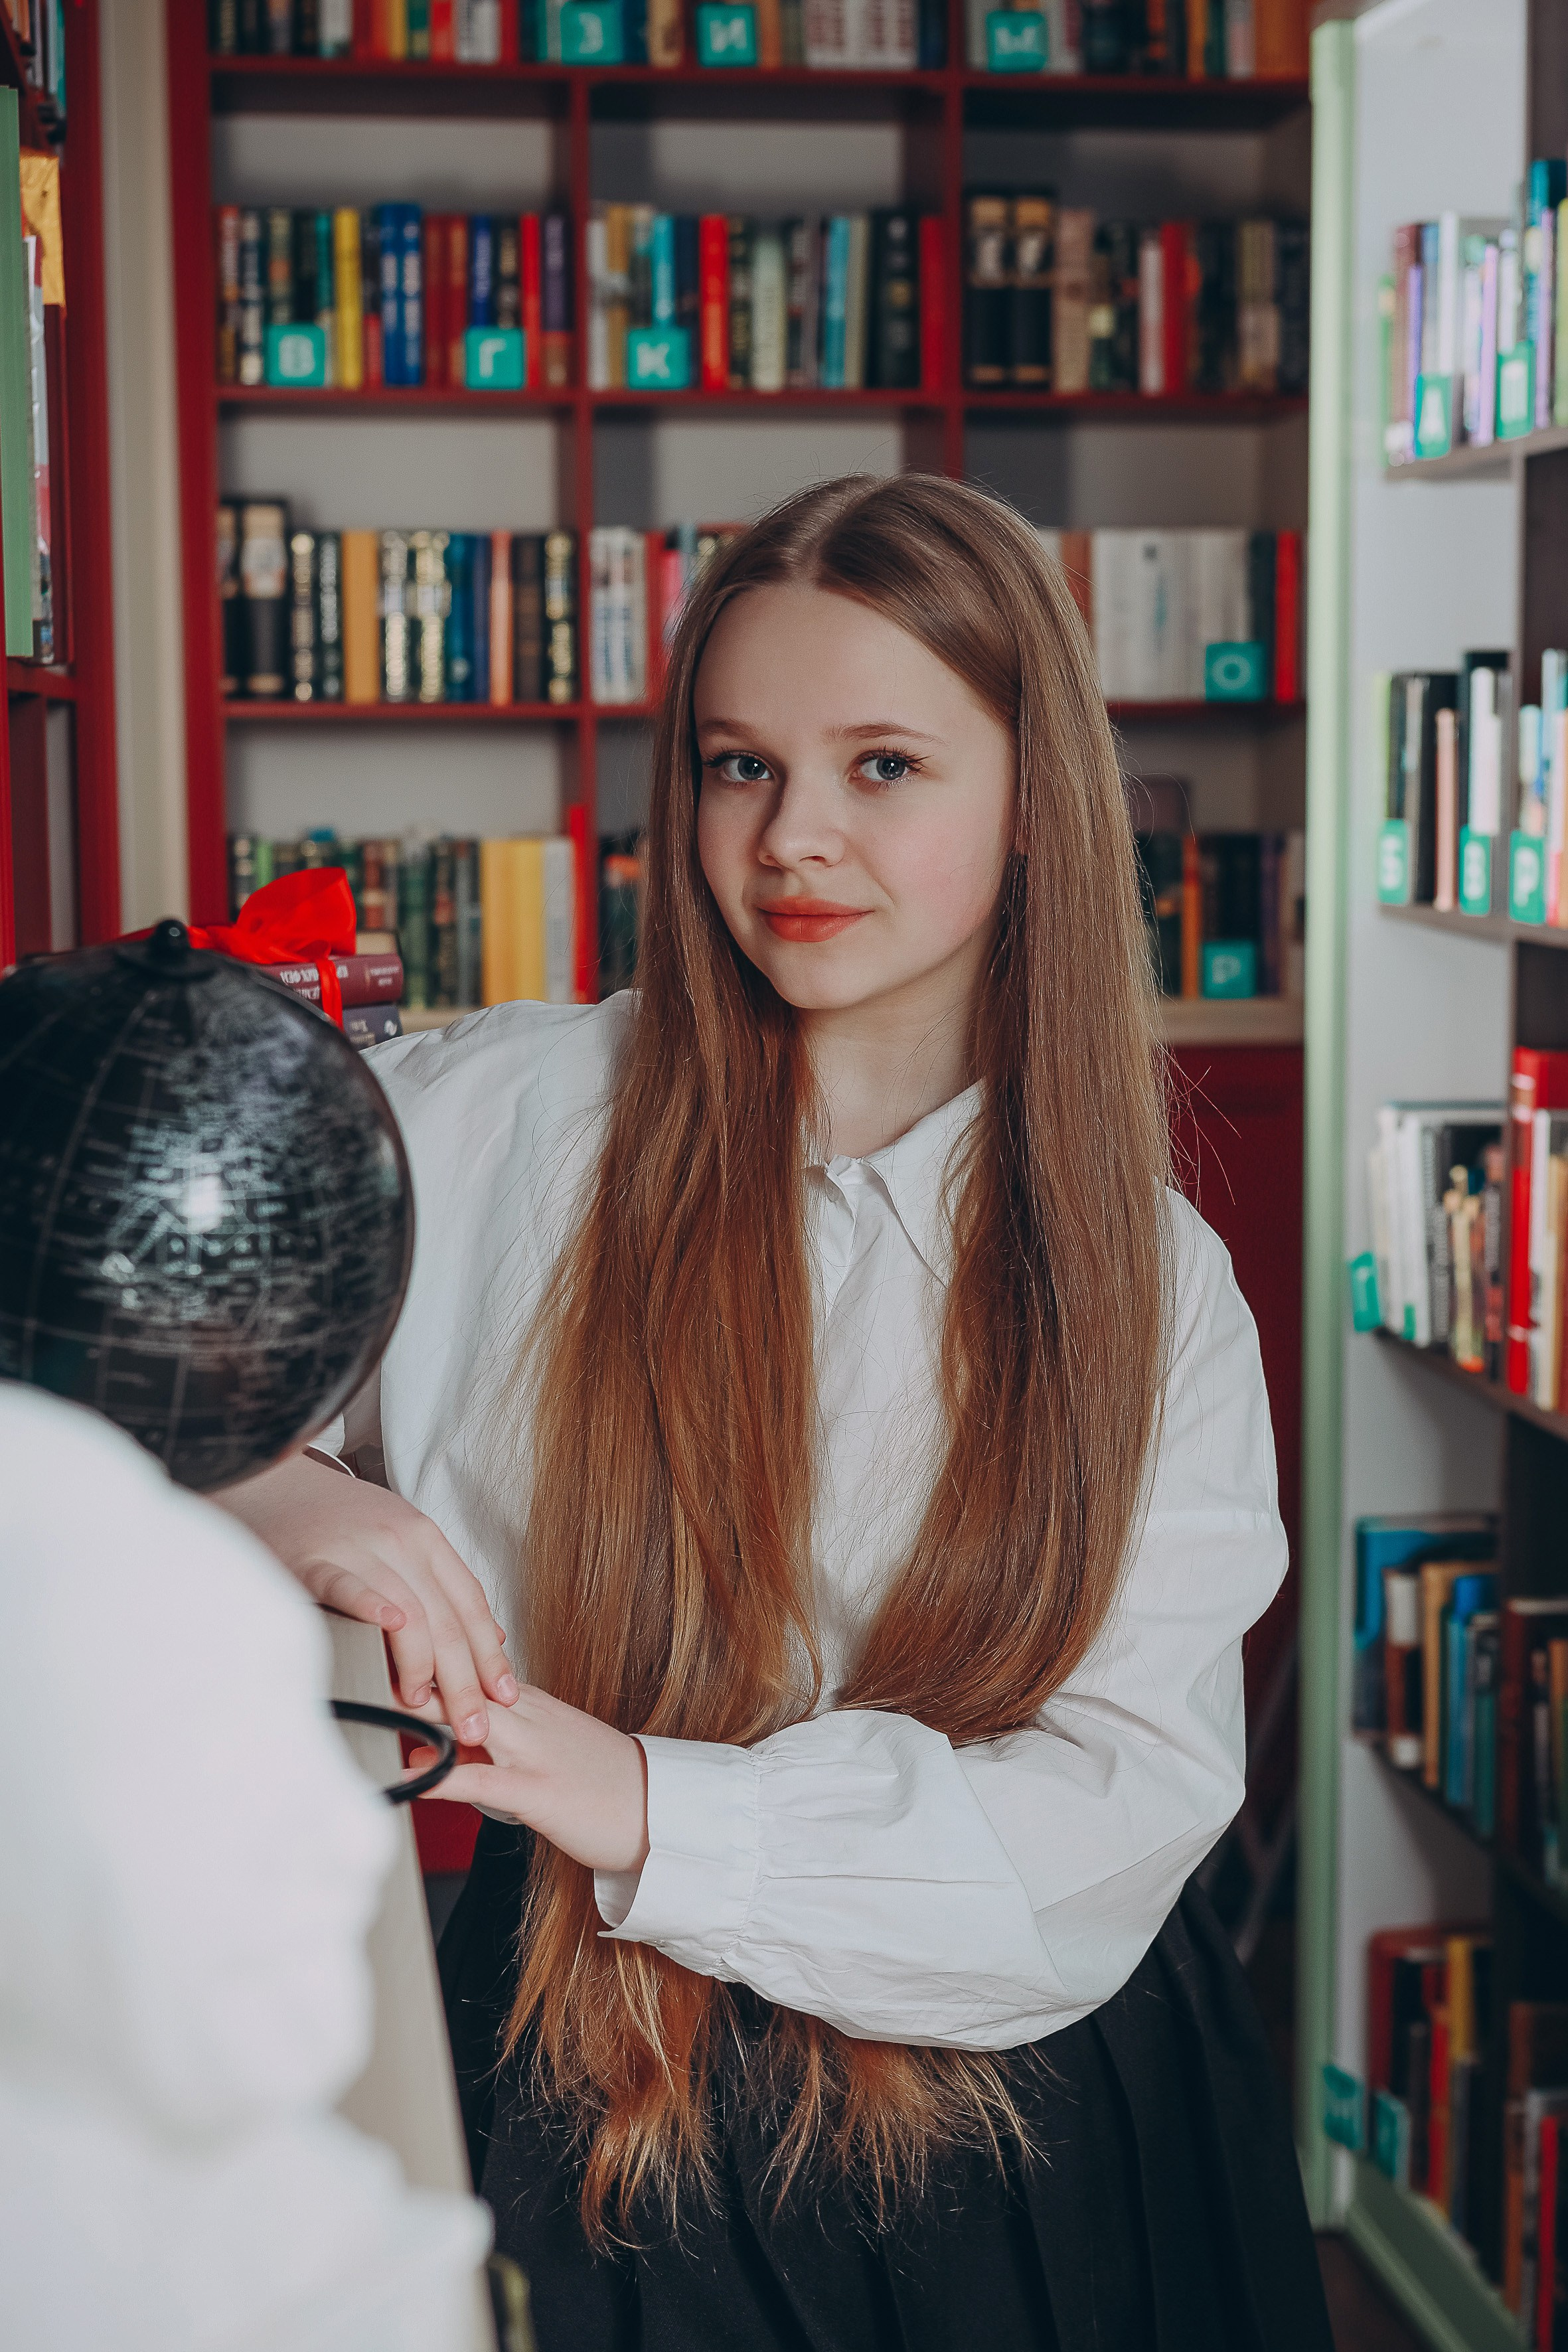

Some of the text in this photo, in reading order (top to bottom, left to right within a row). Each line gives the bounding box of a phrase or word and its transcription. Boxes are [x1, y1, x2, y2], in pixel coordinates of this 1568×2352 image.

[478, 337, 507, 379] Г
[636, 341, 670, 379] К
[1210, 654, 1251, 691] О
